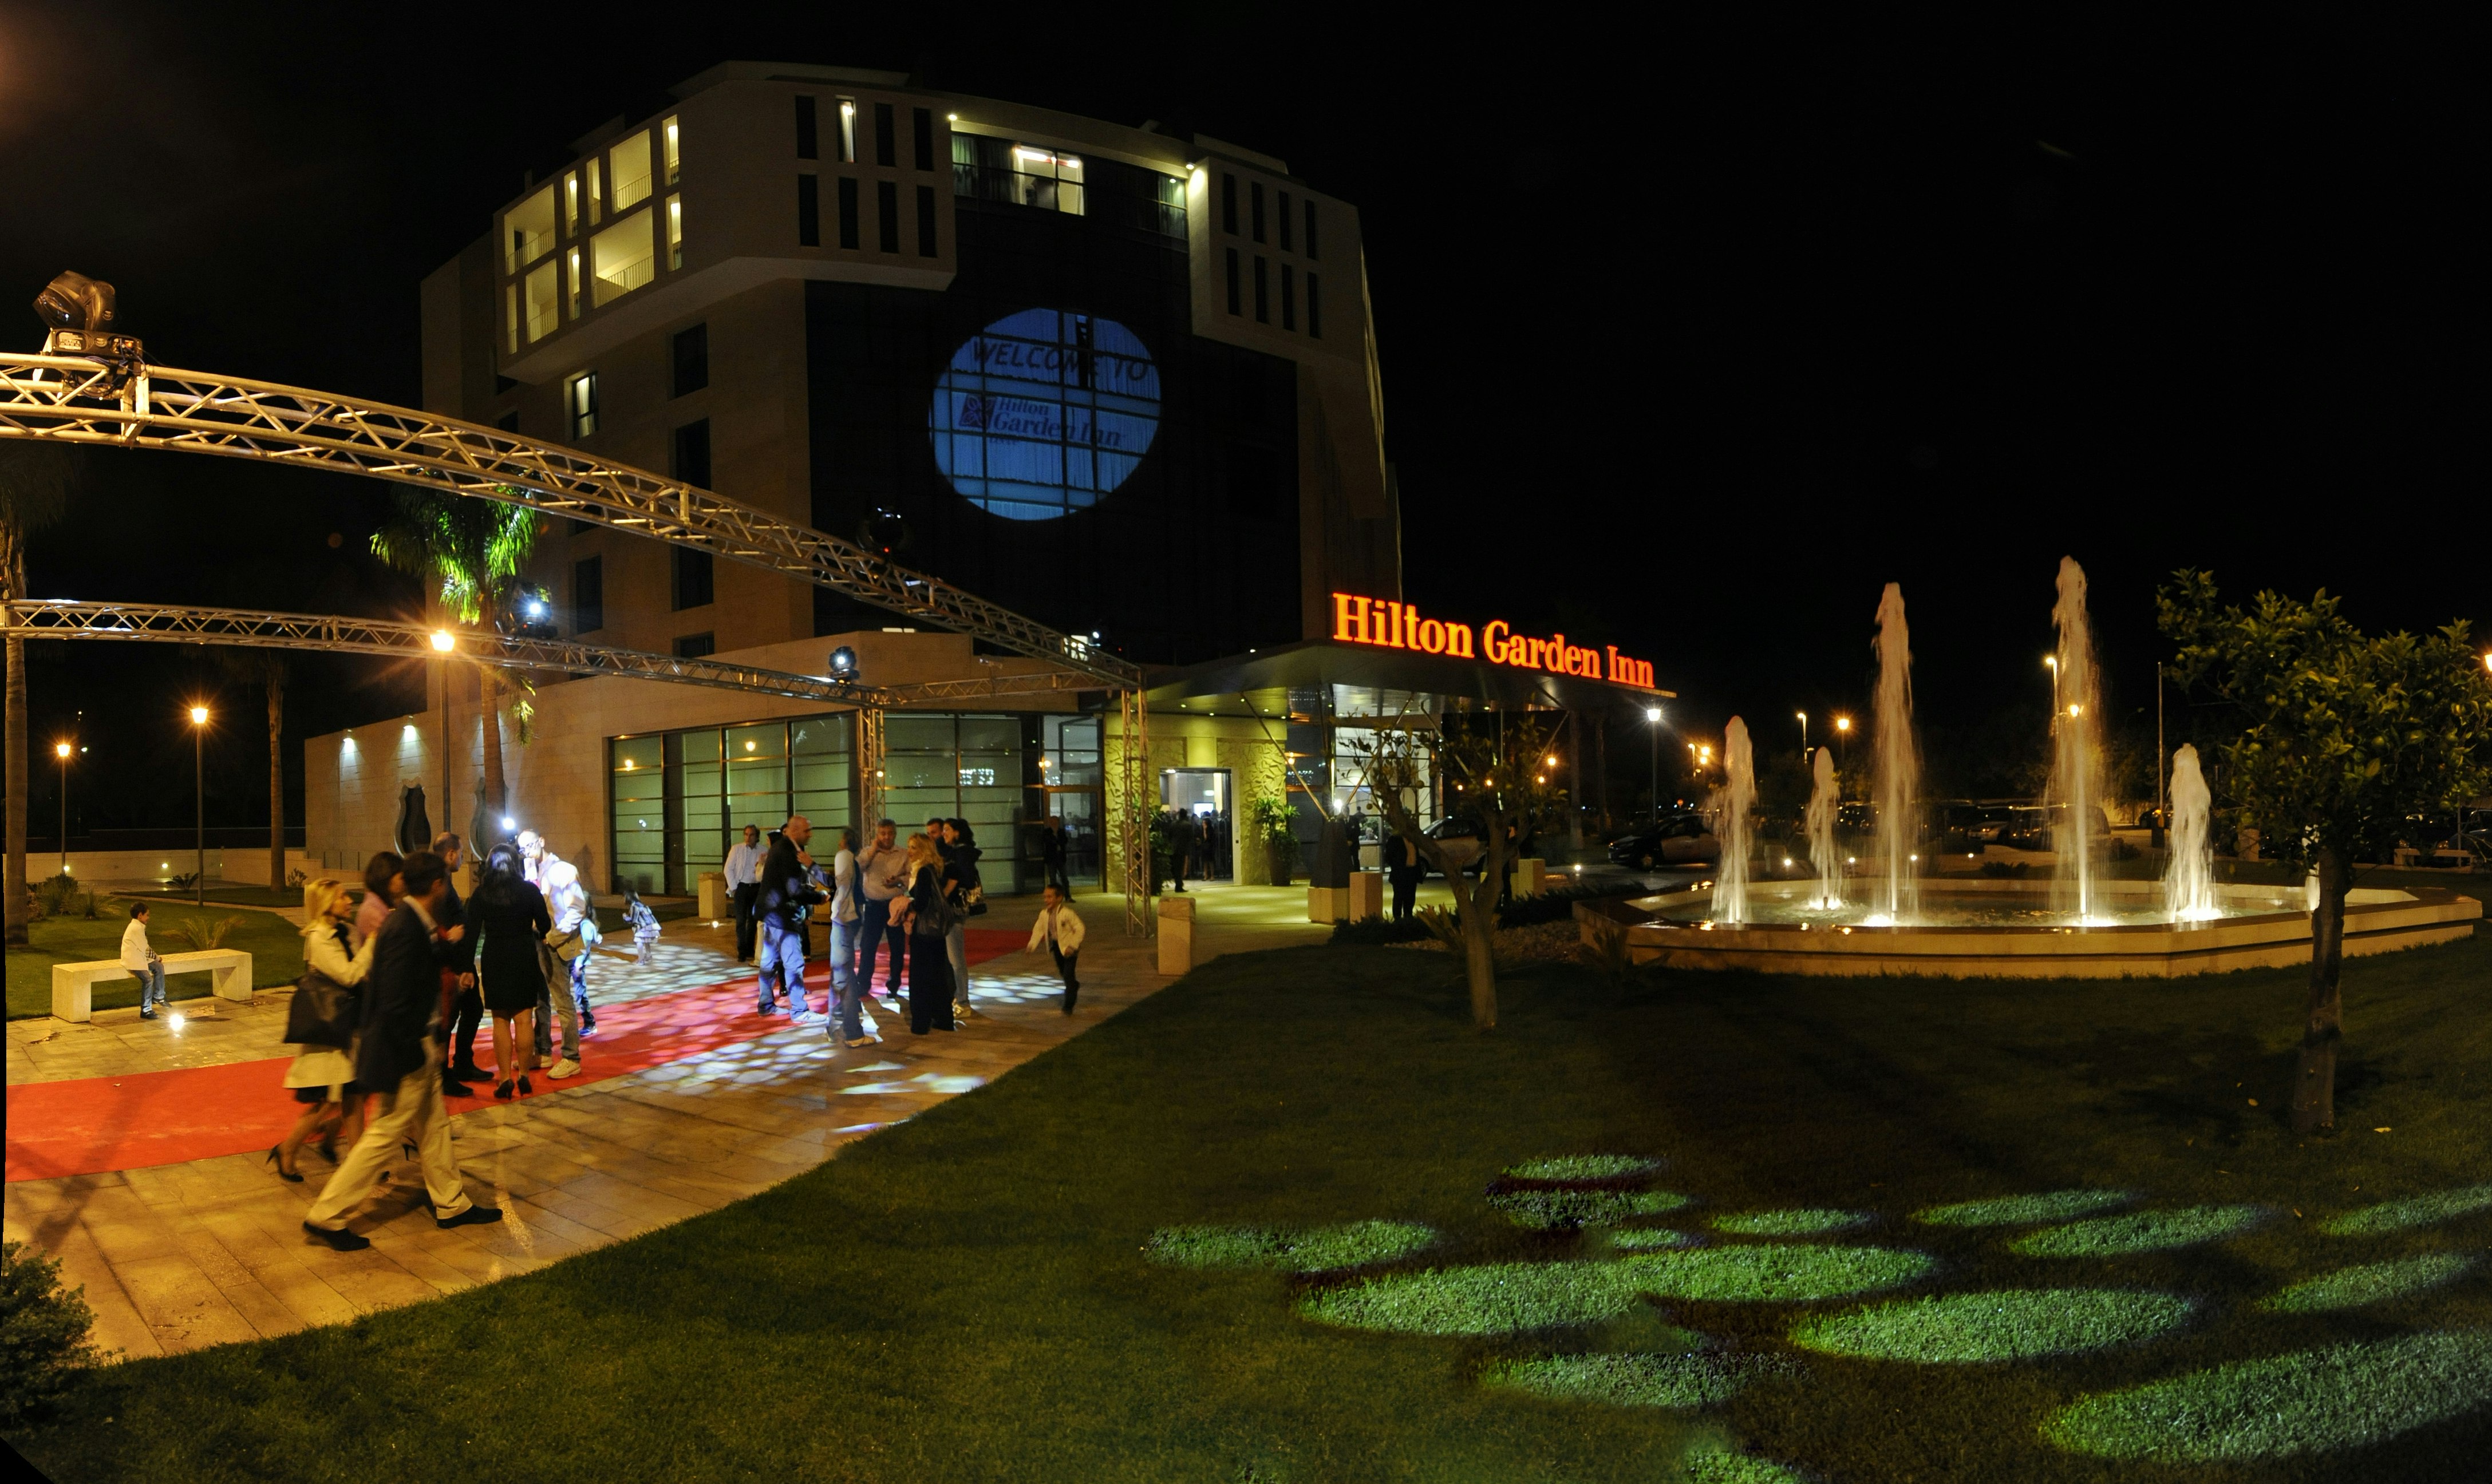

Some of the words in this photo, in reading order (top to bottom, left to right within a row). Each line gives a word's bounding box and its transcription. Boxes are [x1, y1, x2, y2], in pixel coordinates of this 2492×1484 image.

[974, 342, 1098, 376] WELCOM
[998, 398, 1049, 416] Hilton
[1333, 592, 1474, 658] Hilton
[1484, 620, 1602, 679] Garden
[1607, 645, 1655, 688] Inn
